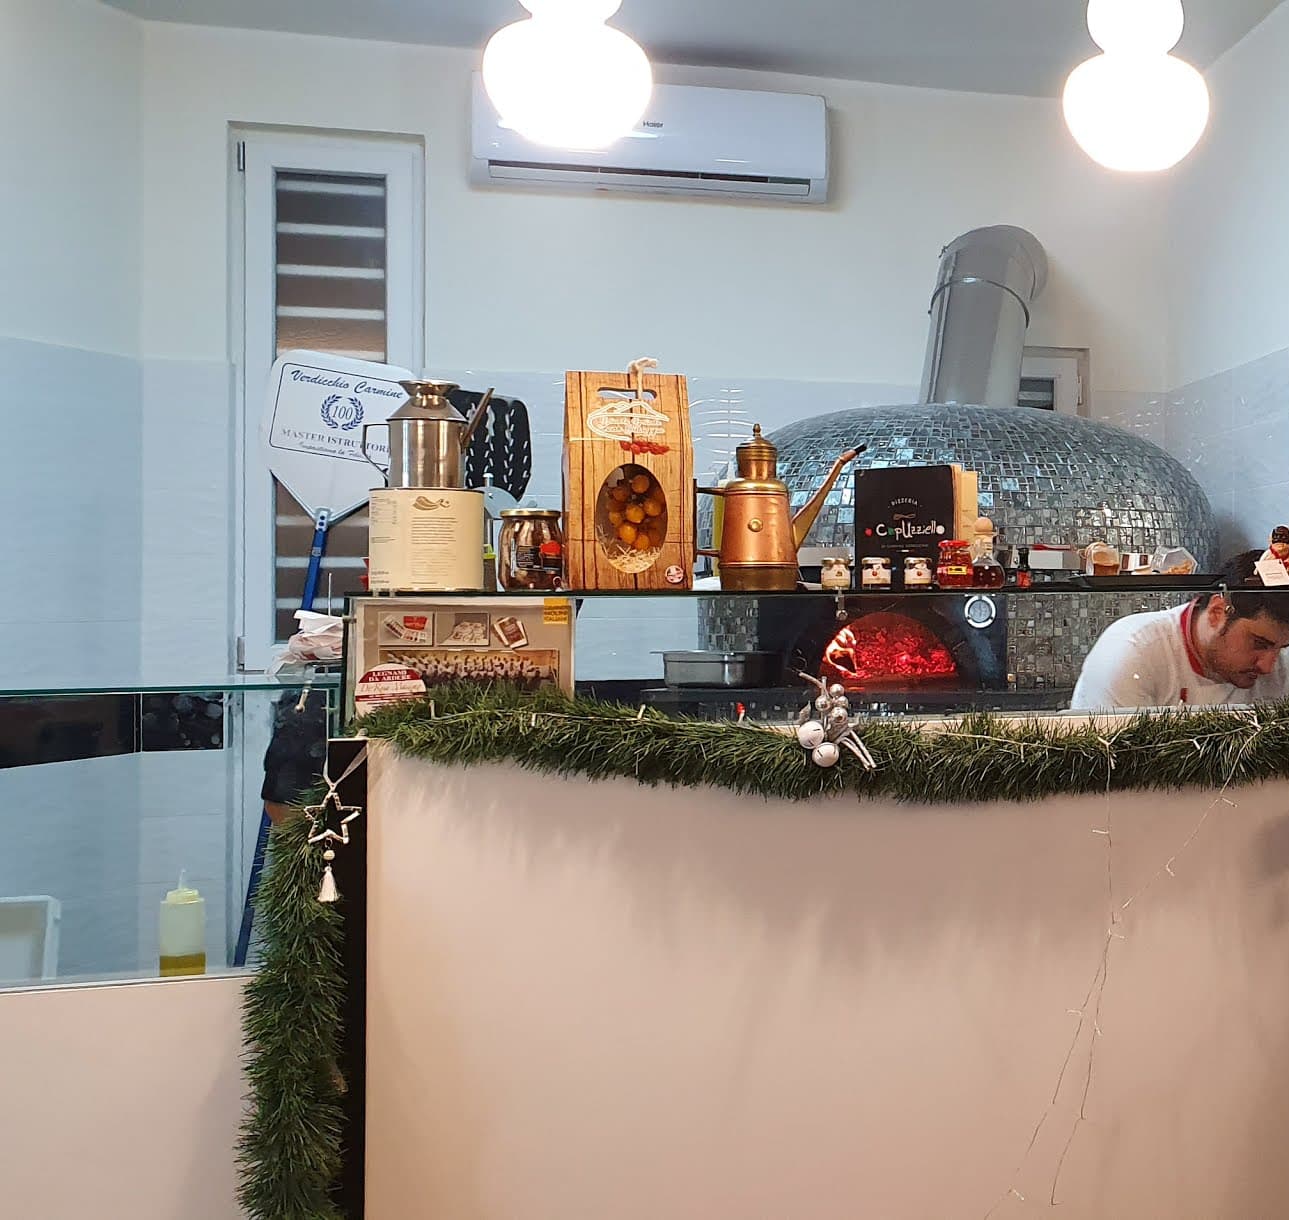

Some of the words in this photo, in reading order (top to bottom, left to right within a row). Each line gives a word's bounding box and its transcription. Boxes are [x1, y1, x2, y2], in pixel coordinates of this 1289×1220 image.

[290, 369, 350, 390] Verdicchio
[353, 381, 404, 400] Carmine
[331, 405, 354, 421] 100
[281, 428, 325, 442] MASTER
